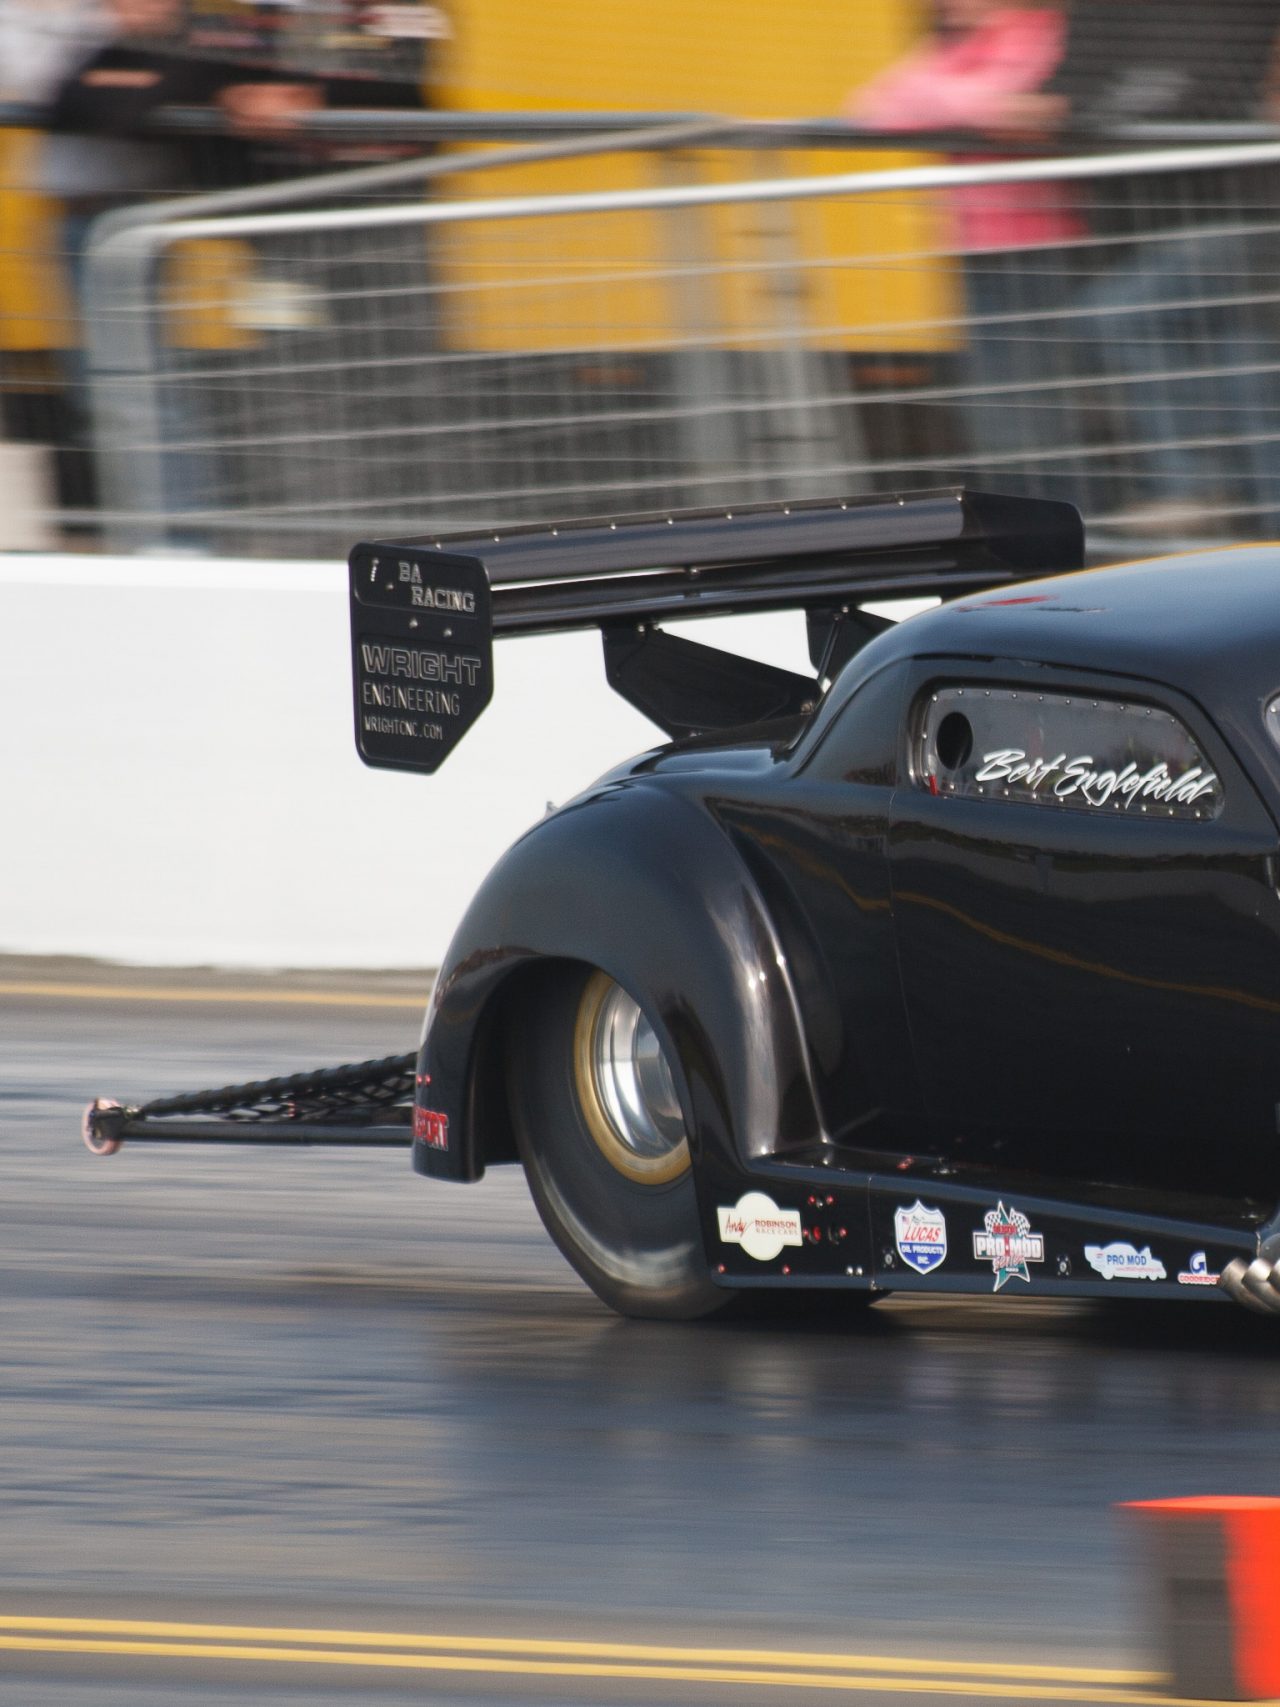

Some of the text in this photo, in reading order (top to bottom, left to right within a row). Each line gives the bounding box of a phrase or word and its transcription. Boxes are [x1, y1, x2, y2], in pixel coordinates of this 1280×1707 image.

[399, 561, 423, 584] BA
[411, 585, 476, 613] RACING
[361, 643, 481, 686] WRIGHT
[363, 681, 460, 716] ENGINEERING
[364, 715, 443, 740] WRIGHTCNC.COM
[1054, 755, 1217, 809] Englefield
[755, 1219, 797, 1229] ROBINSON
[903, 1224, 942, 1242] LUCAS
[1106, 1254, 1147, 1266] PRO MOD
